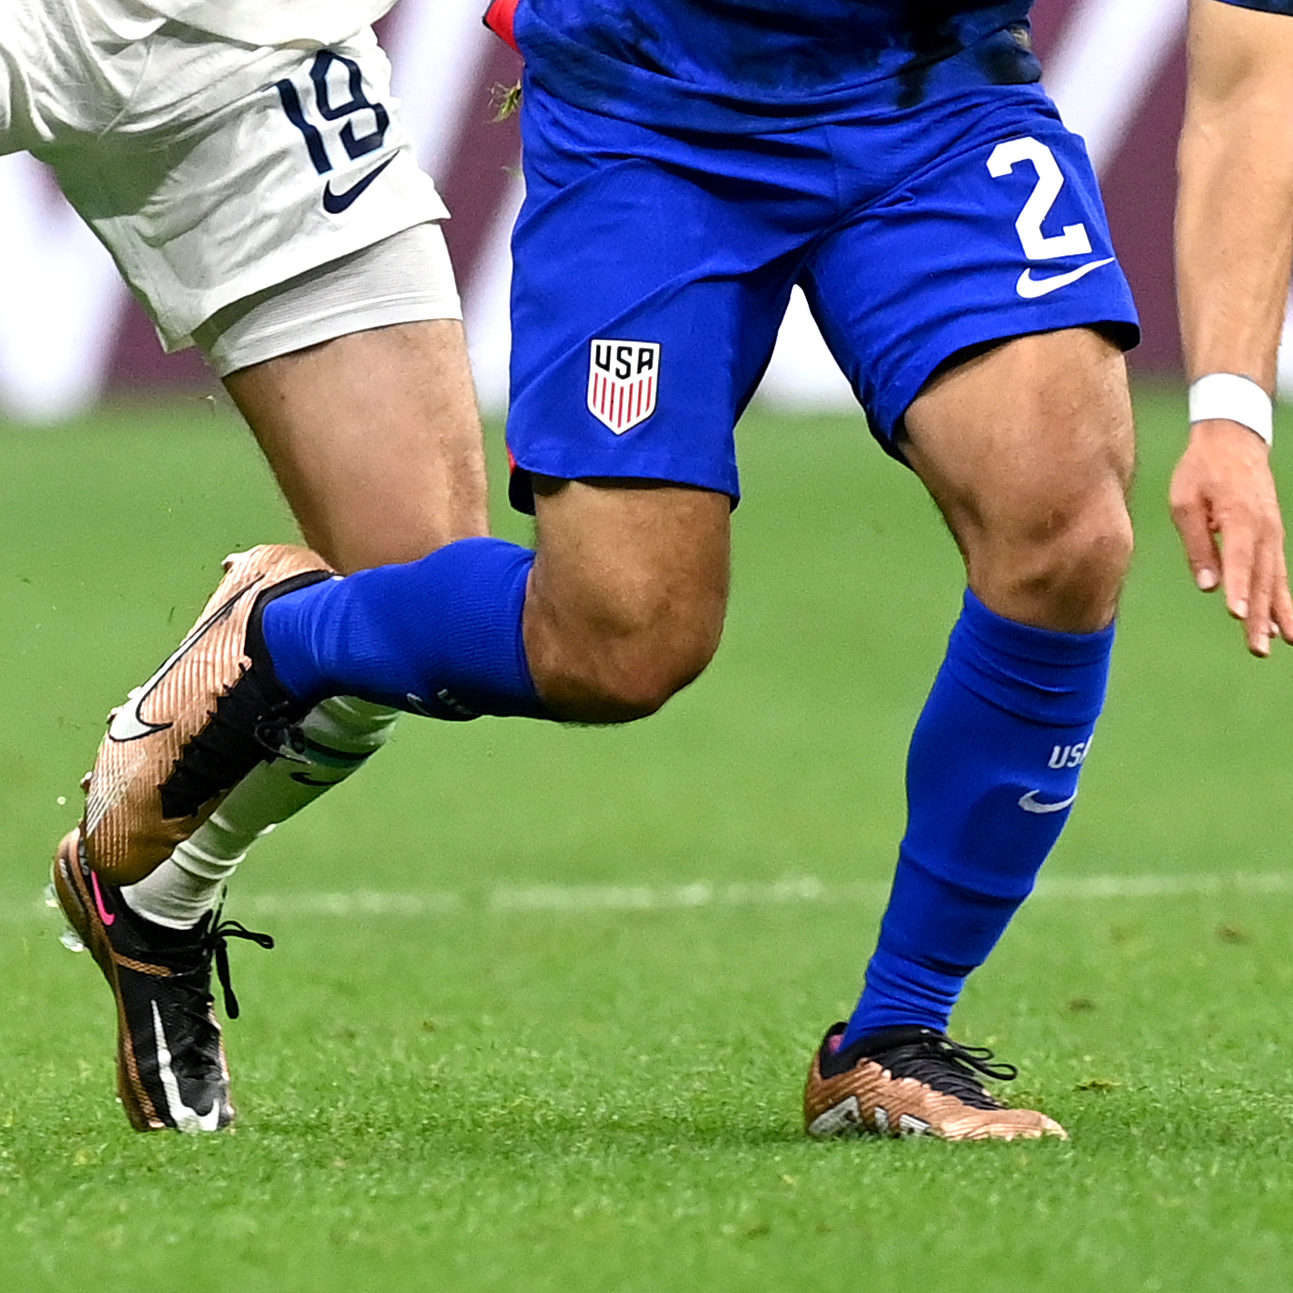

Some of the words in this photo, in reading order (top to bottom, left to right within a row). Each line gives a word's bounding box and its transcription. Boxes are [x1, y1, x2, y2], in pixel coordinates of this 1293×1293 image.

[268, 49, 390, 175] 19
[986, 136, 1093, 260] 2
[595, 344, 654, 380] USA
